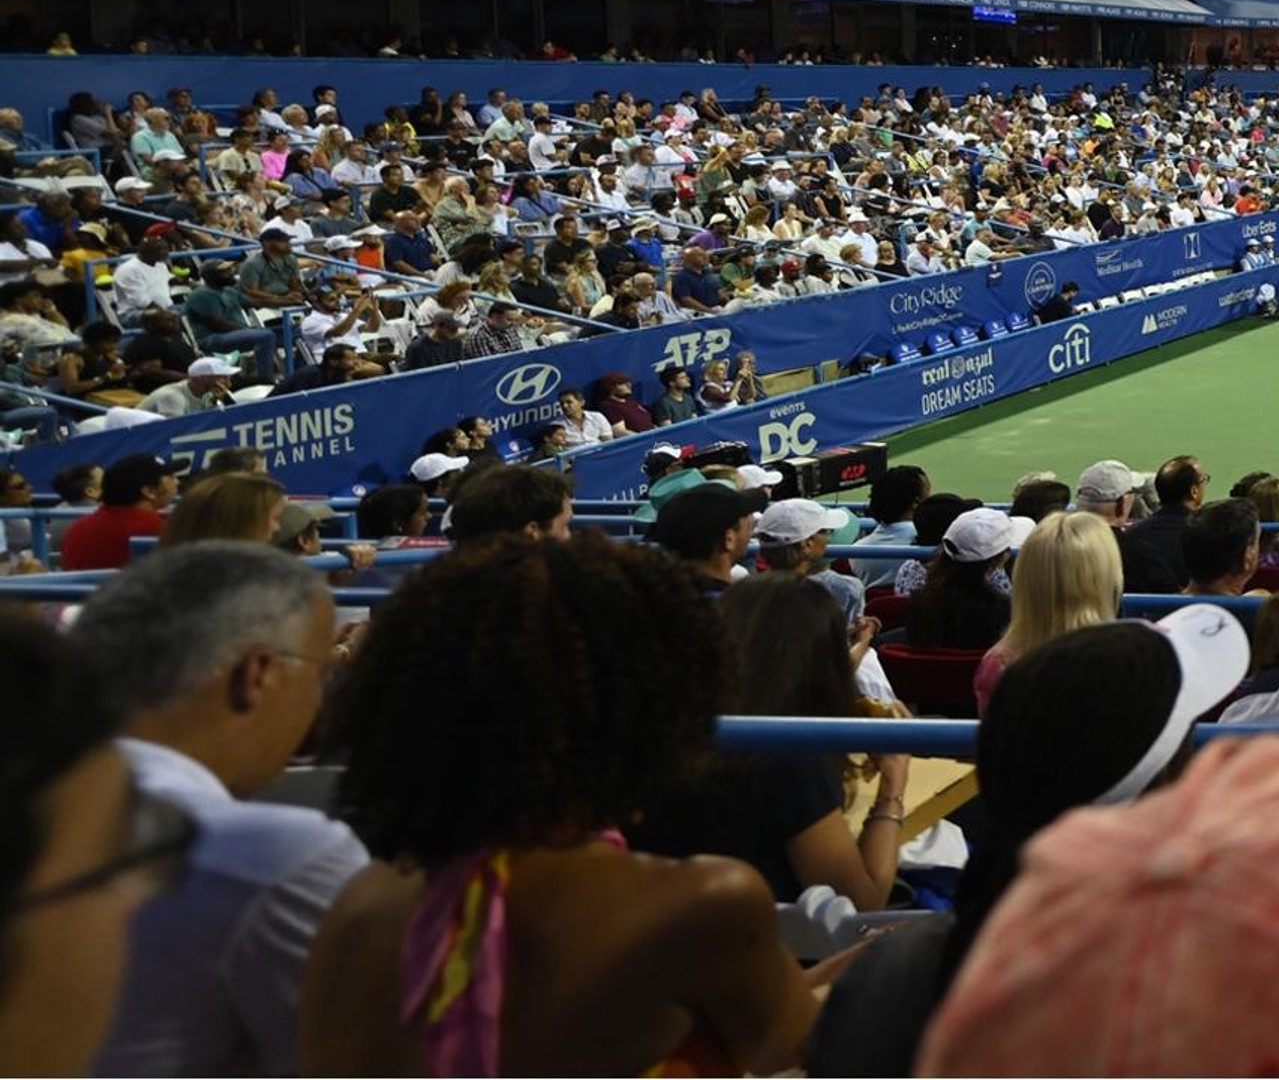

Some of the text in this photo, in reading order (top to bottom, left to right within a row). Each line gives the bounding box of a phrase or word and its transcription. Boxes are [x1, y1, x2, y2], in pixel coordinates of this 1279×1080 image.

[1242, 221, 1277, 237] Uber Eats
[1123, 258, 1144, 271] Health
[890, 283, 963, 315] CityRidge
[1157, 306, 1188, 321] MODERN
[1048, 323, 1091, 374] citi
[770, 402, 806, 419] events
[922, 374, 995, 416] DREAM SEATS
[233, 403, 355, 450] TENNIS
[489, 401, 564, 434] HYUNDA
[758, 412, 818, 464] DC
[264, 439, 355, 472] ANNEL
